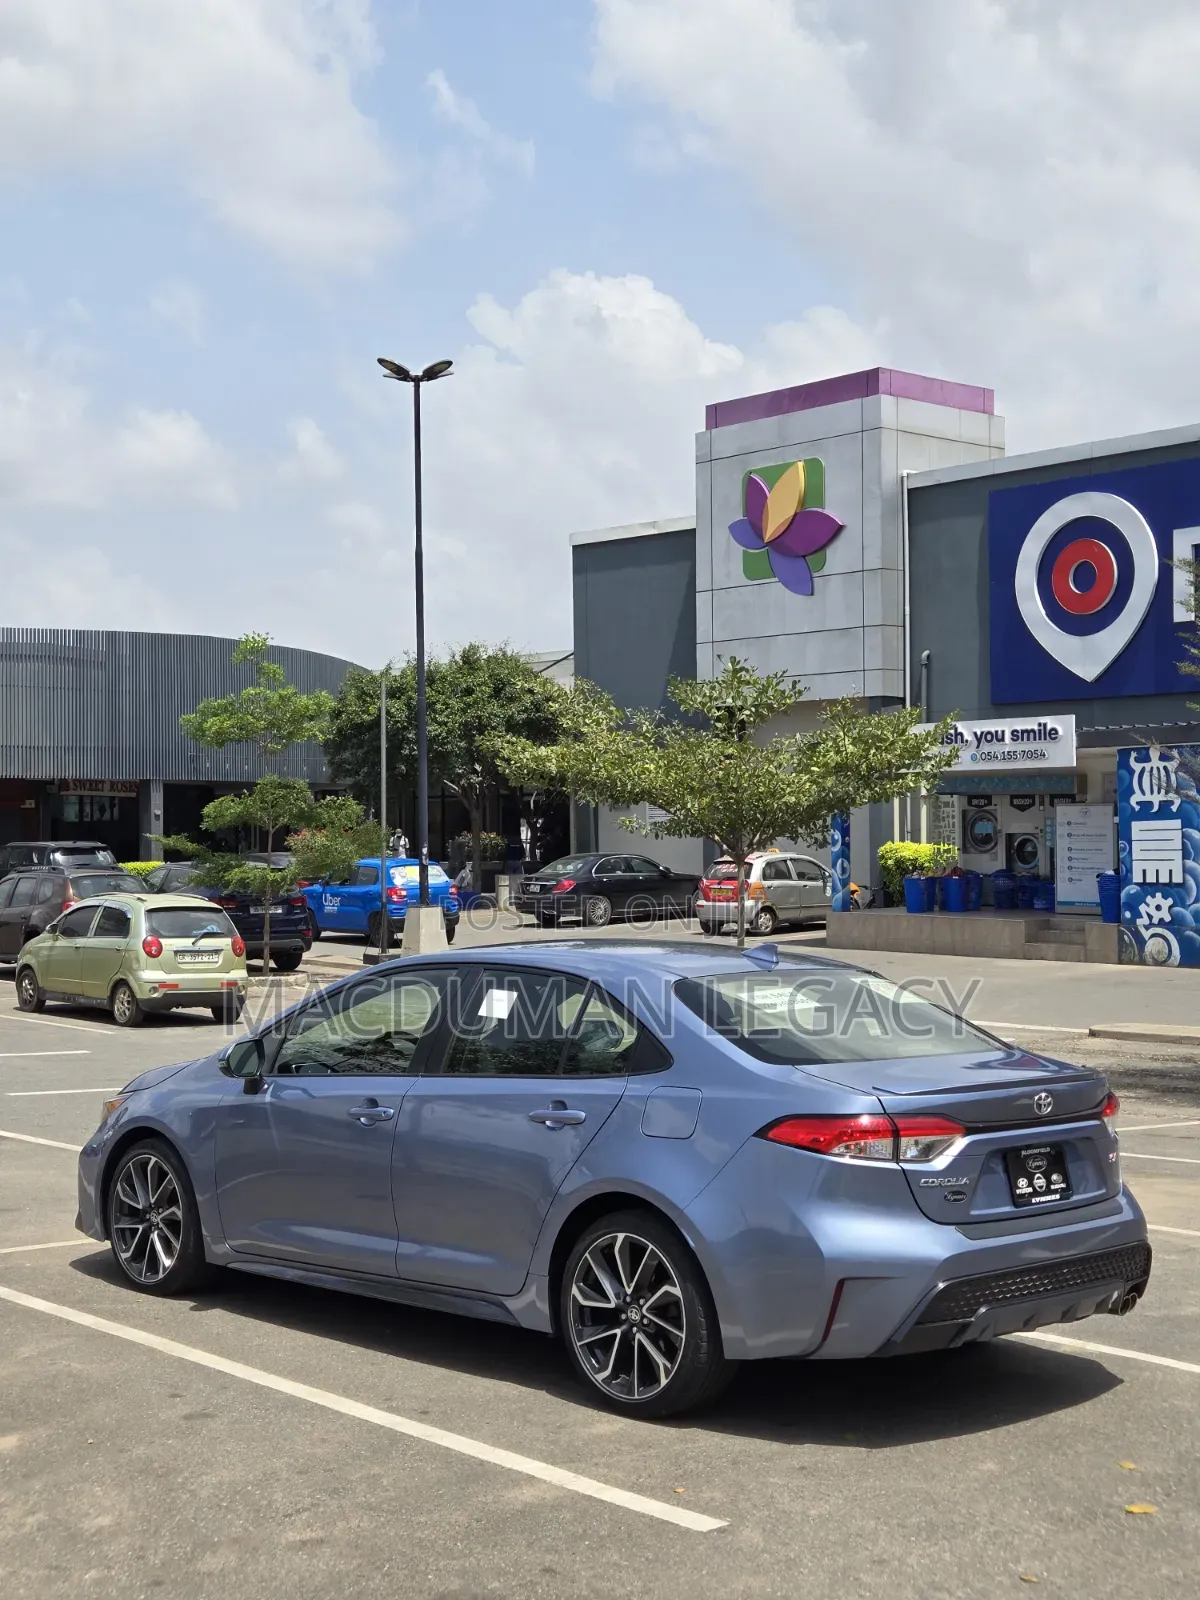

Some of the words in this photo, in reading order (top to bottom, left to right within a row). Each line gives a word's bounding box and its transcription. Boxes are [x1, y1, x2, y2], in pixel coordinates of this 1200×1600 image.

[973, 729, 1005, 748] you
[1010, 722, 1059, 743] smile
[980, 751, 999, 761] 054
[1001, 750, 1018, 760] 155
[1019, 749, 1046, 760] 7054
[72, 780, 106, 792] SWEET
[109, 781, 139, 793] ROSES
[322, 893, 341, 906] Uber
[1021, 1147, 1051, 1156] BLOOMFIELD
[919, 1177, 970, 1187] COROLLA
